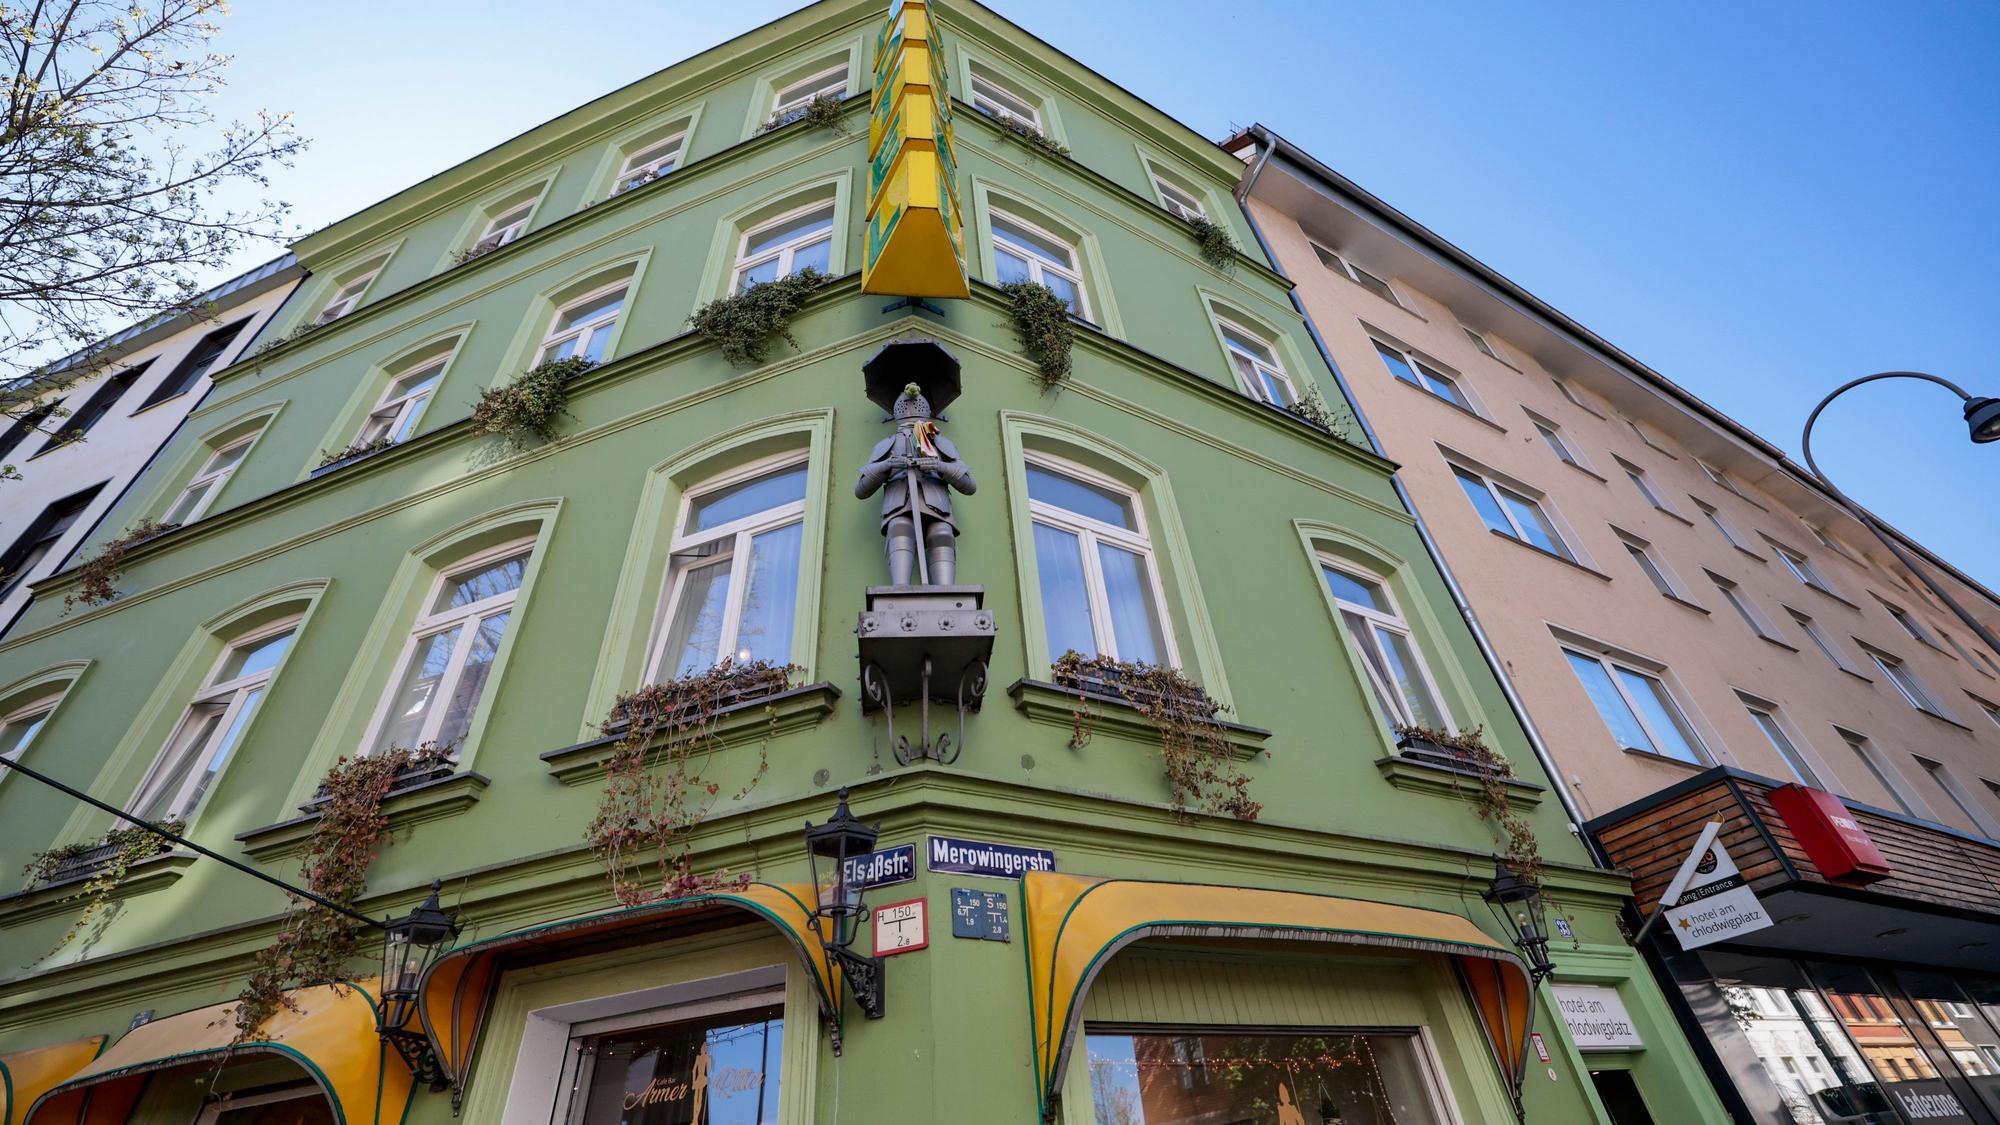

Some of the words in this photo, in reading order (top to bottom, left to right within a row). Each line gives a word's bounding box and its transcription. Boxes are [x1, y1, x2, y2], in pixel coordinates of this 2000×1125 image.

[843, 851, 909, 882] Elsaßstr.
[933, 838, 1052, 875] Merowingerstr
[1700, 880, 1734, 896] Entrance
[877, 911, 884, 922] H
[892, 905, 911, 919] 150
[969, 899, 980, 907] 150
[986, 897, 994, 909] S
[997, 902, 1007, 910] 150
[1690, 908, 1718, 925] hotel
[1719, 904, 1736, 916] am
[1691, 910, 1762, 938] chlodwigplatz
[1557, 996, 1587, 1013] hotel
[1587, 1001, 1605, 1013] am
[1567, 1019, 1632, 1041] hlodwigplatz
[623, 1078, 688, 1110] Armer
